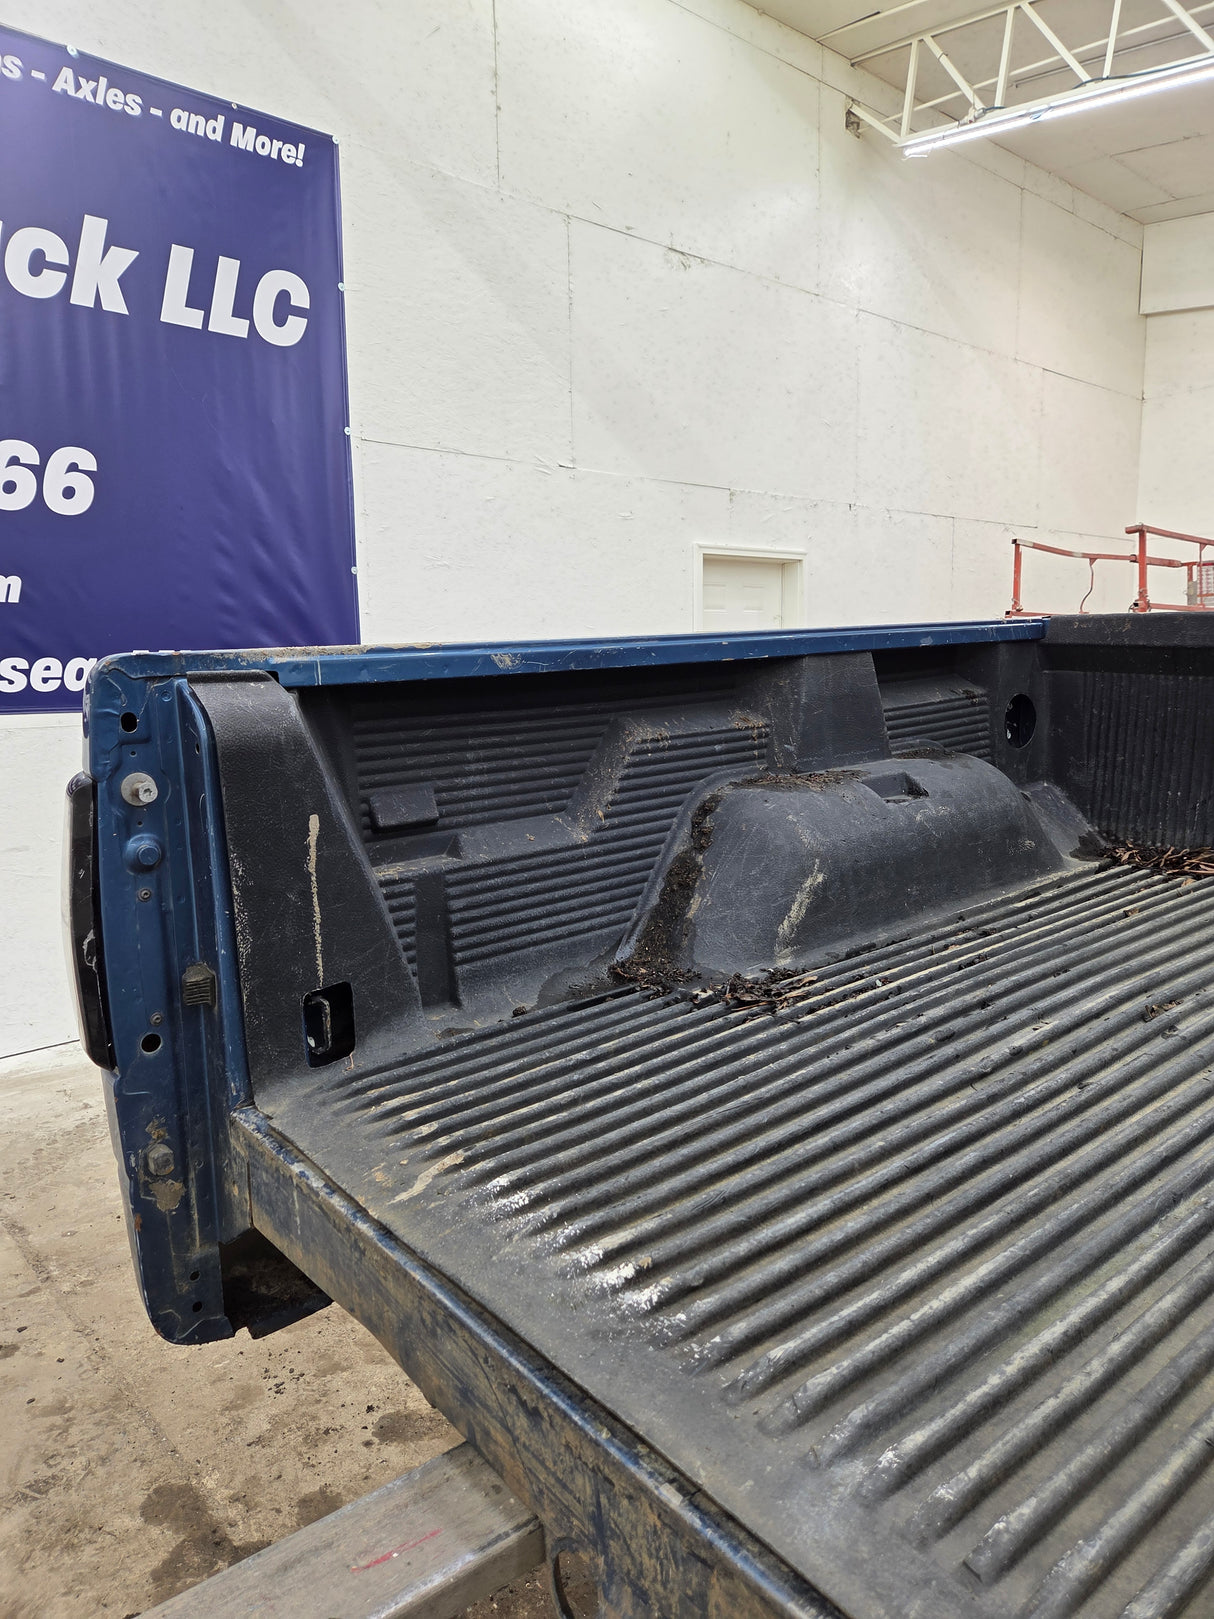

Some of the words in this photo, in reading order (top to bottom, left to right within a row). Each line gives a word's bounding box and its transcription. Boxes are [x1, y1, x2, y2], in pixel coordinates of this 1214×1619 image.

[0, 55, 23, 79] s
[52, 66, 143, 116] Axles
[170, 107, 225, 142] and
[230, 122, 306, 167] More!
[0, 215, 139, 314] ck
[160, 244, 309, 346] LLC
[0, 440, 97, 515] 66
